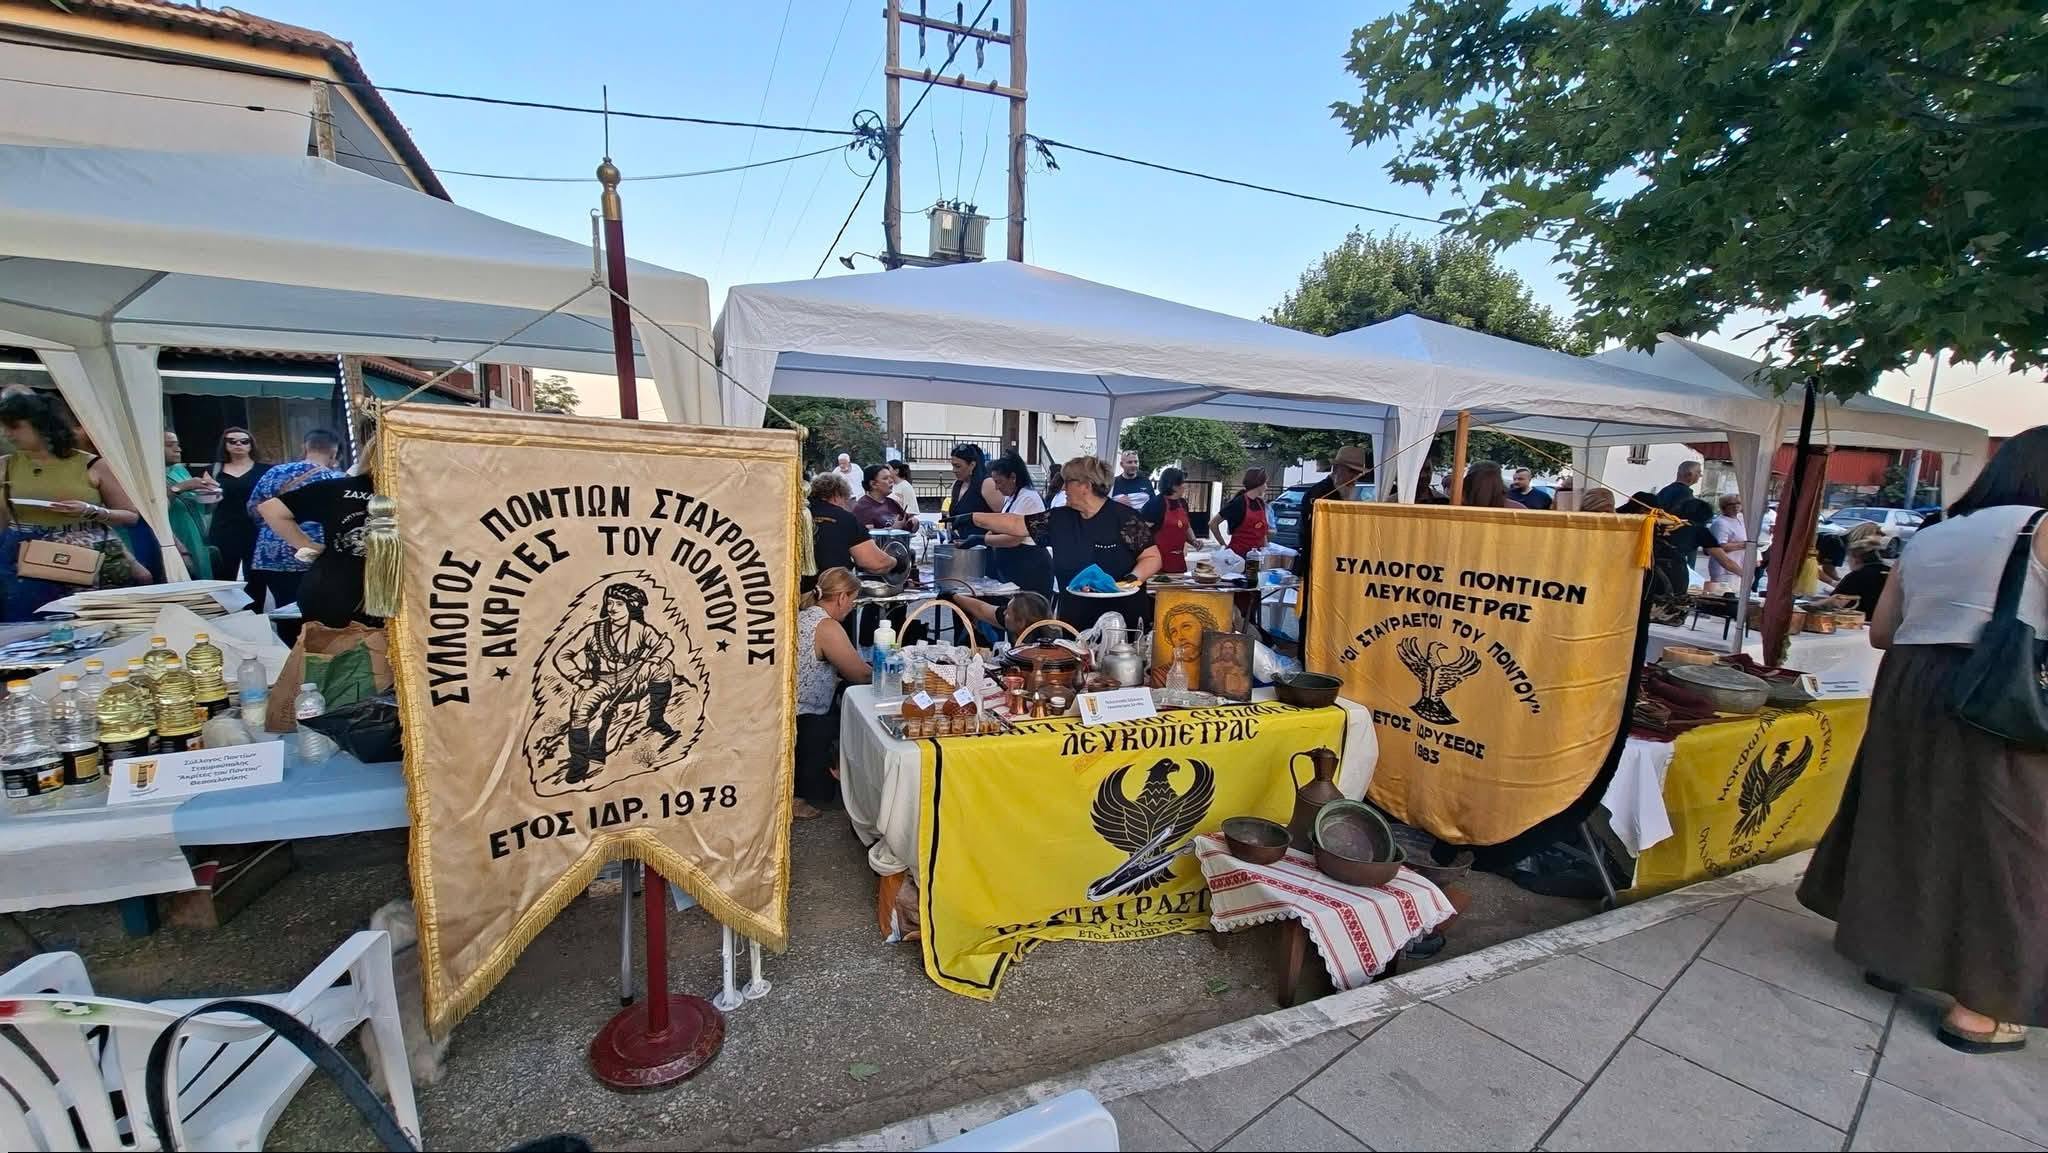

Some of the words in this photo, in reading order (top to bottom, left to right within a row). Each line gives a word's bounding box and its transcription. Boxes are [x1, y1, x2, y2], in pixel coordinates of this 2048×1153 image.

[427, 550, 482, 707] ΣΥΛΛΟΓΟΣ
[480, 485, 630, 543] ΠΟΝΤΙΩΝ
[650, 488, 776, 666] ΣΤΑΥΡΟΥΠΟΛΗΣ
[481, 528, 570, 658] ΑΚΡΙΤΕΣ
[597, 525, 662, 556] ΤΟΥ
[671, 537, 737, 636] ΠΟΝΤΟΥ
[1335, 556, 1445, 582] ΣΥΛΛΟΓΟΣ
[1460, 570, 1587, 605] ΠΟΝΤΙΩΝ
[1365, 582, 1533, 623] ΛΕΥΚΟΠΕΤΡΑΣ
[1356, 612, 1442, 648] ΣΤΑΥΡΑΕΤΟΙ
[1452, 619, 1485, 643] ΤΟΥ
[1373, 711, 1411, 732] ΕΤΟΣ
[1416, 722, 1485, 760] ΙΔΡΥΣΕΩΣ
[1414, 741, 1440, 764] 1983
[489, 810, 577, 859] ΕΤΟΣ
[589, 797, 648, 830] ΙΔΡ.
[661, 785, 738, 818] 1978
